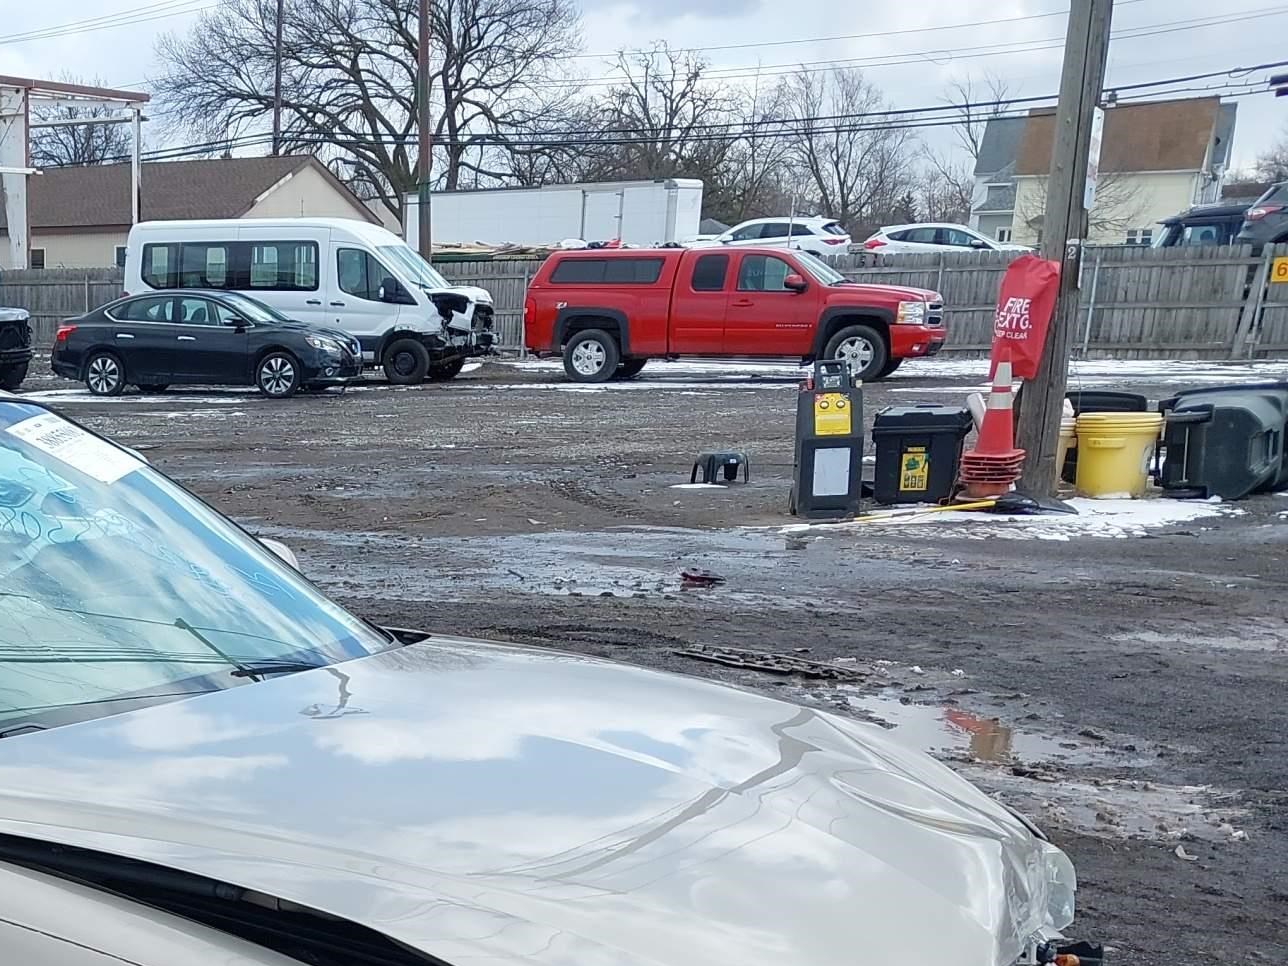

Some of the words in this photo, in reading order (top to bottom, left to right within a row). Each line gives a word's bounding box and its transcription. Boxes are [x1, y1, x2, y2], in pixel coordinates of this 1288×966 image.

[1067, 246, 1077, 260] 2
[1276, 262, 1288, 277] 6
[1004, 297, 1032, 314] FIRE
[998, 311, 1033, 330] EXTG.
